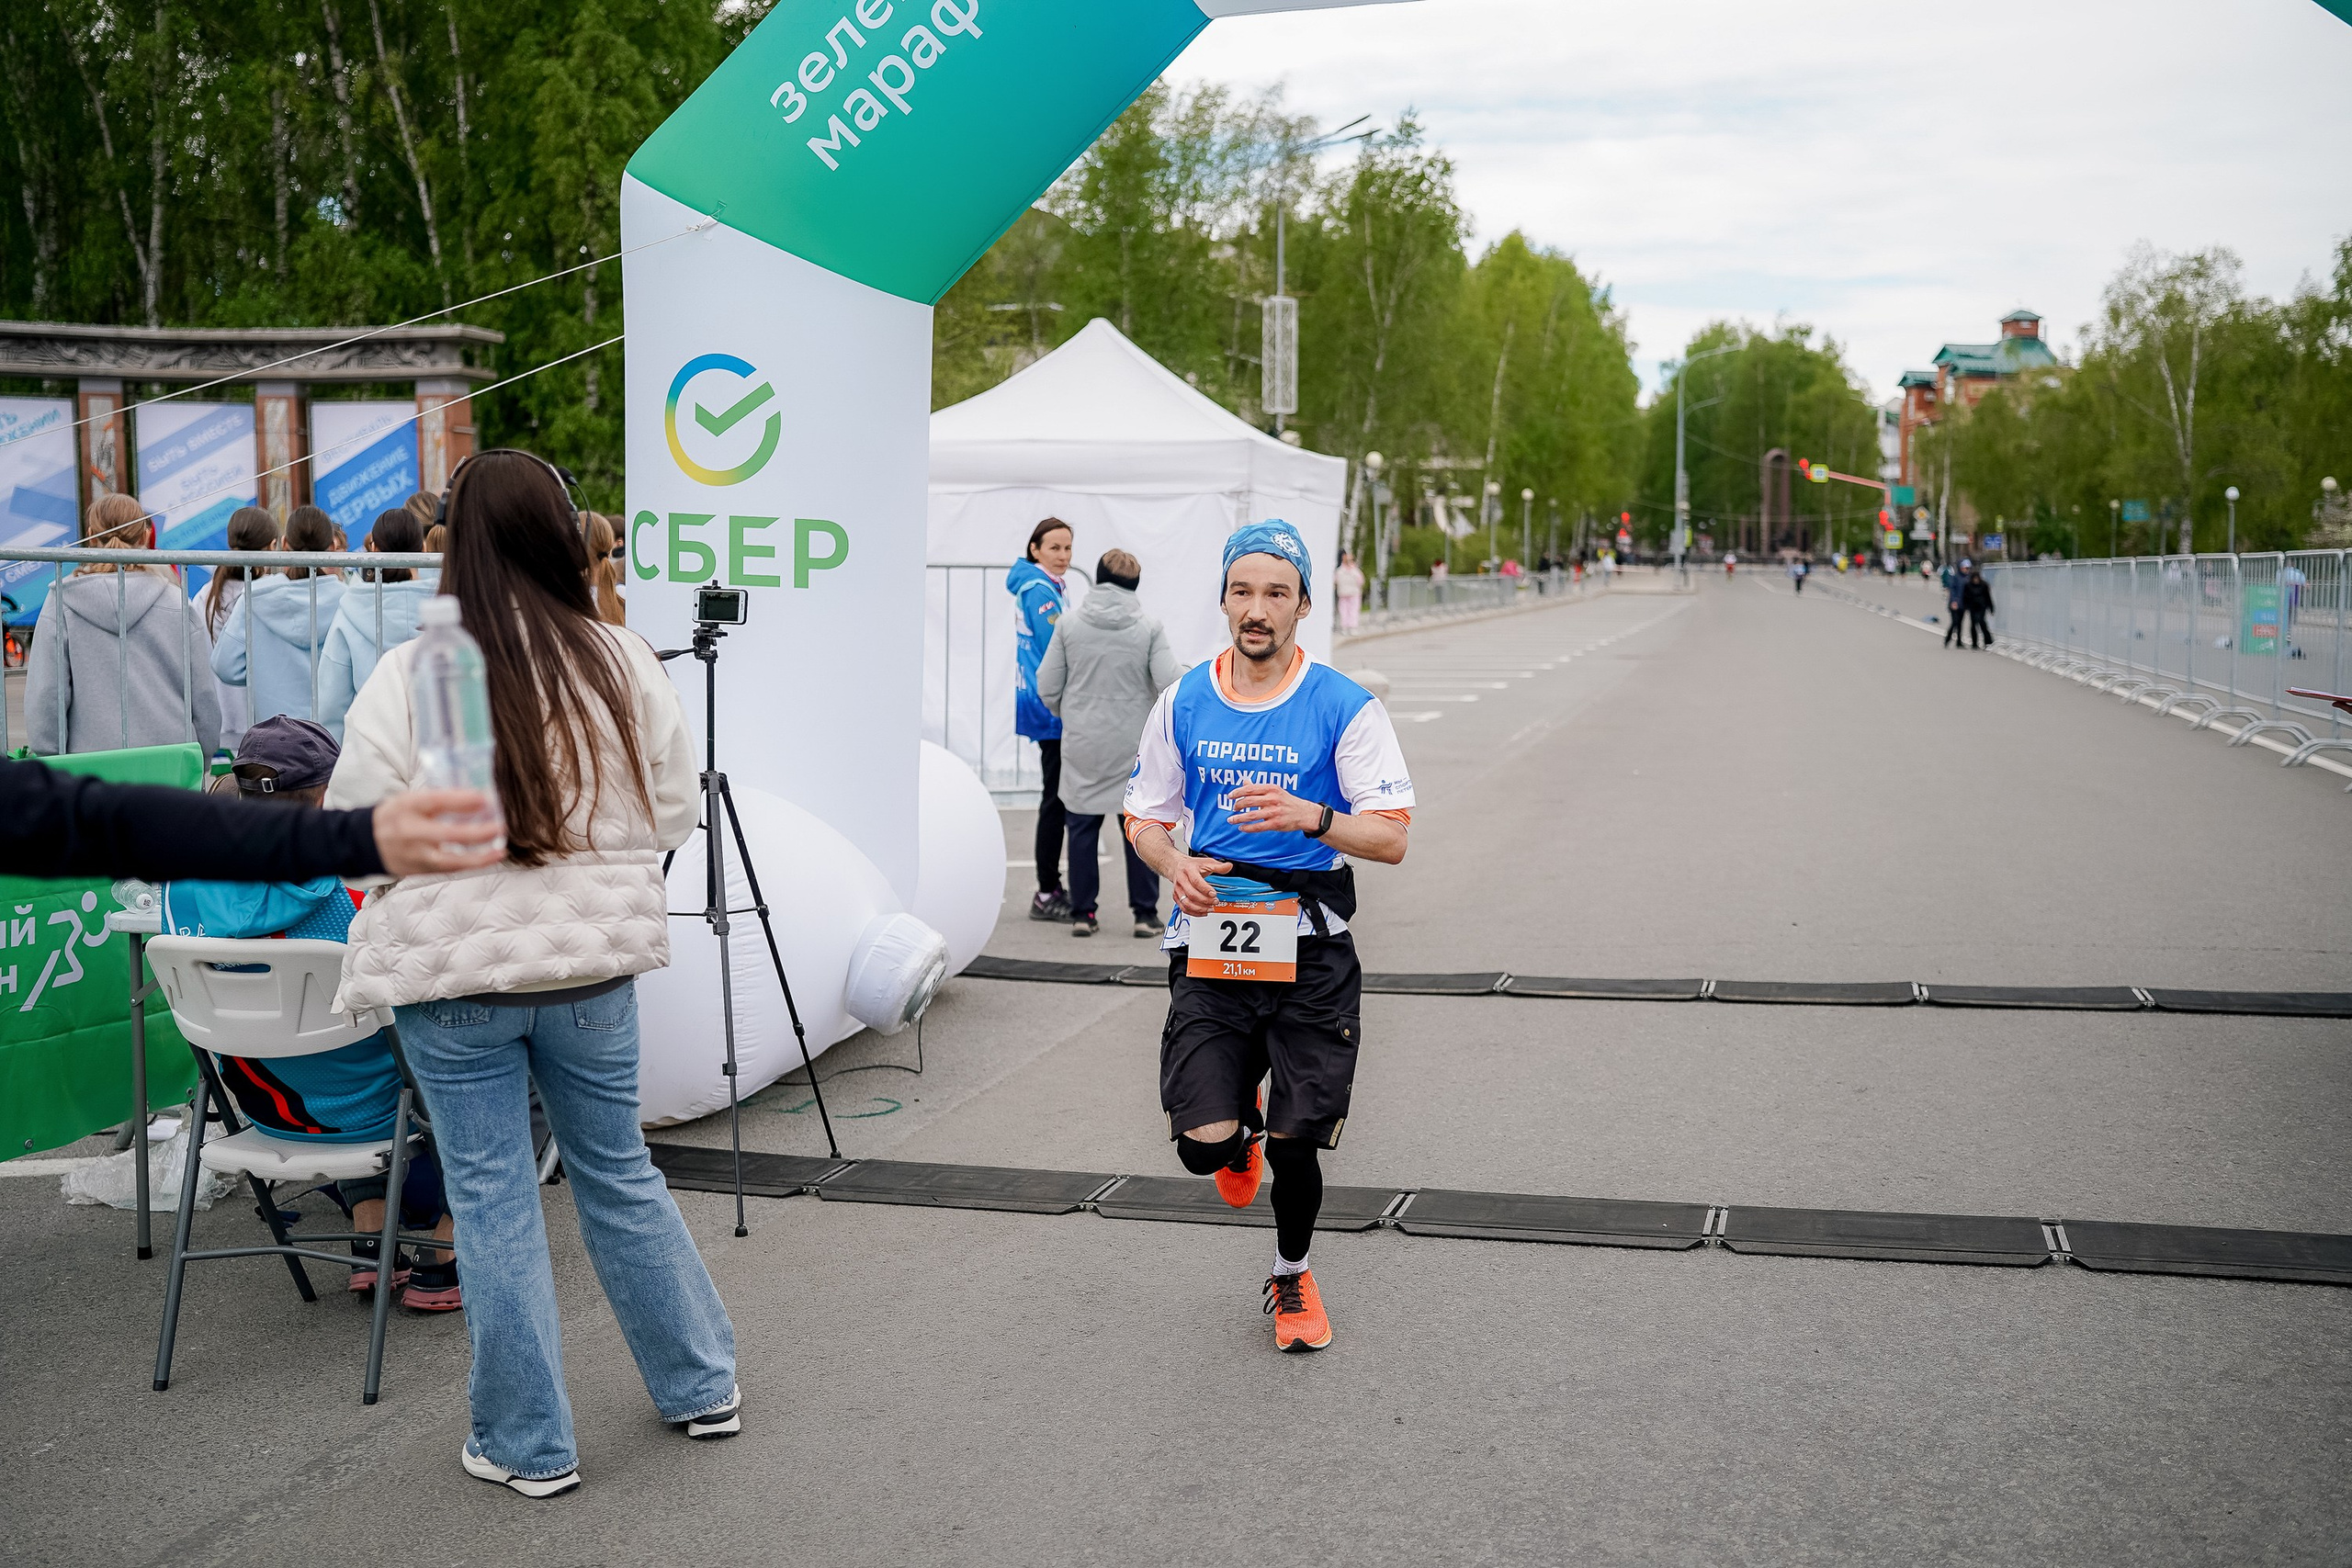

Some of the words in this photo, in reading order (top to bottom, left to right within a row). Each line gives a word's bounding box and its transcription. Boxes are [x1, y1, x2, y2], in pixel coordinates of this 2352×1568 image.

[769, 0, 907, 124] зеле
[187, 412, 243, 451] ВМЕСТЕ
[327, 445, 410, 509] ДВИЖЕНИЕ
[631, 510, 849, 589] СБЕР
[1197, 739, 1299, 764] ГОРДОСТЬ
[1197, 766, 1205, 784] В
[1219, 919, 1261, 953] 22
